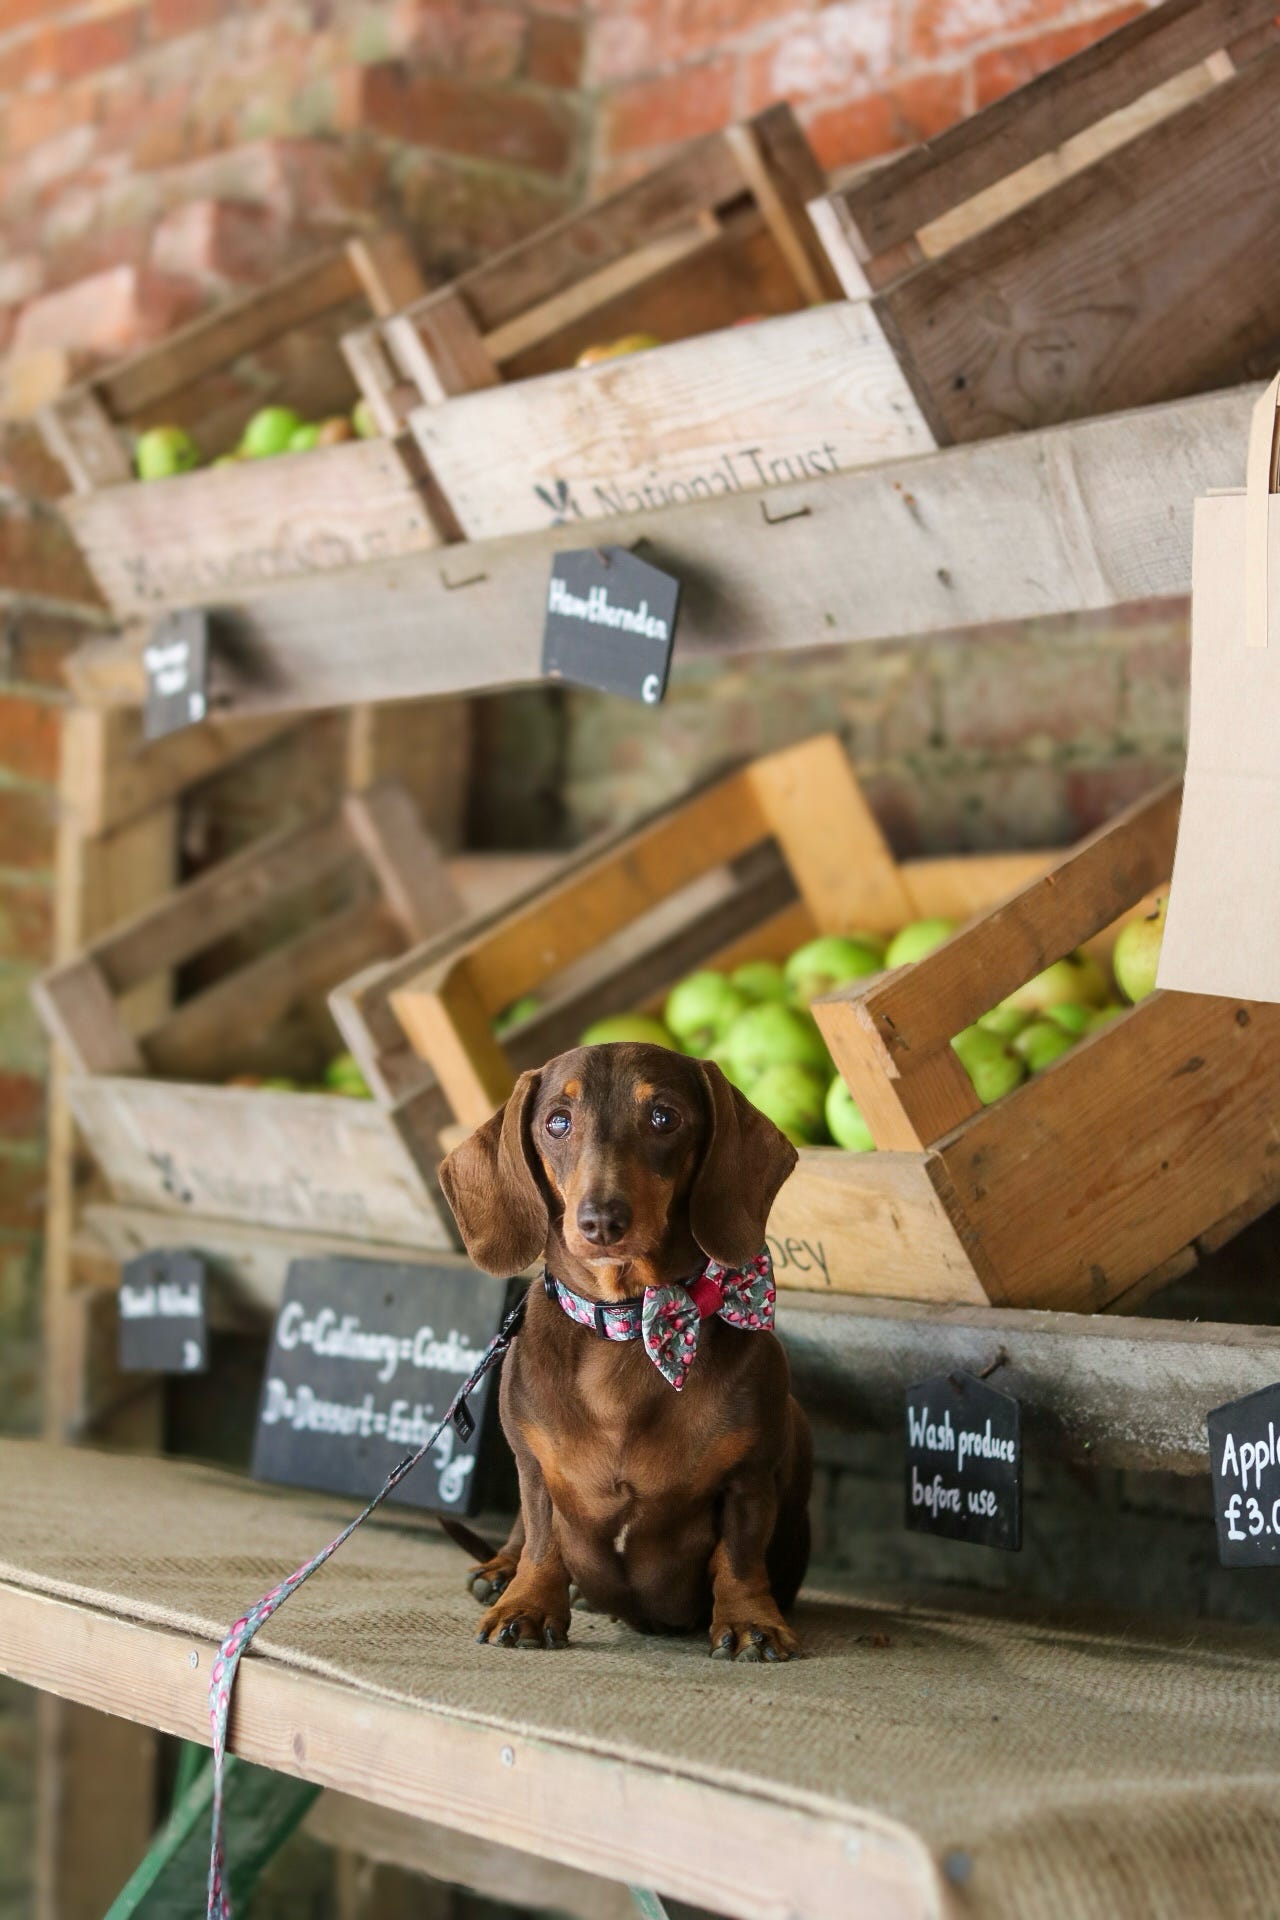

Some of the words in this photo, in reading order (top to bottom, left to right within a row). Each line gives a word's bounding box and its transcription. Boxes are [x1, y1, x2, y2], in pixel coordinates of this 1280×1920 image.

[593, 454, 740, 517] National
[740, 443, 839, 486] Trust
[642, 674, 659, 703] C
[908, 1406, 954, 1451] Wash
[958, 1418, 1015, 1472] produce
[1221, 1421, 1280, 1491] Appl
[912, 1465, 961, 1518] before
[968, 1489, 998, 1517] use
